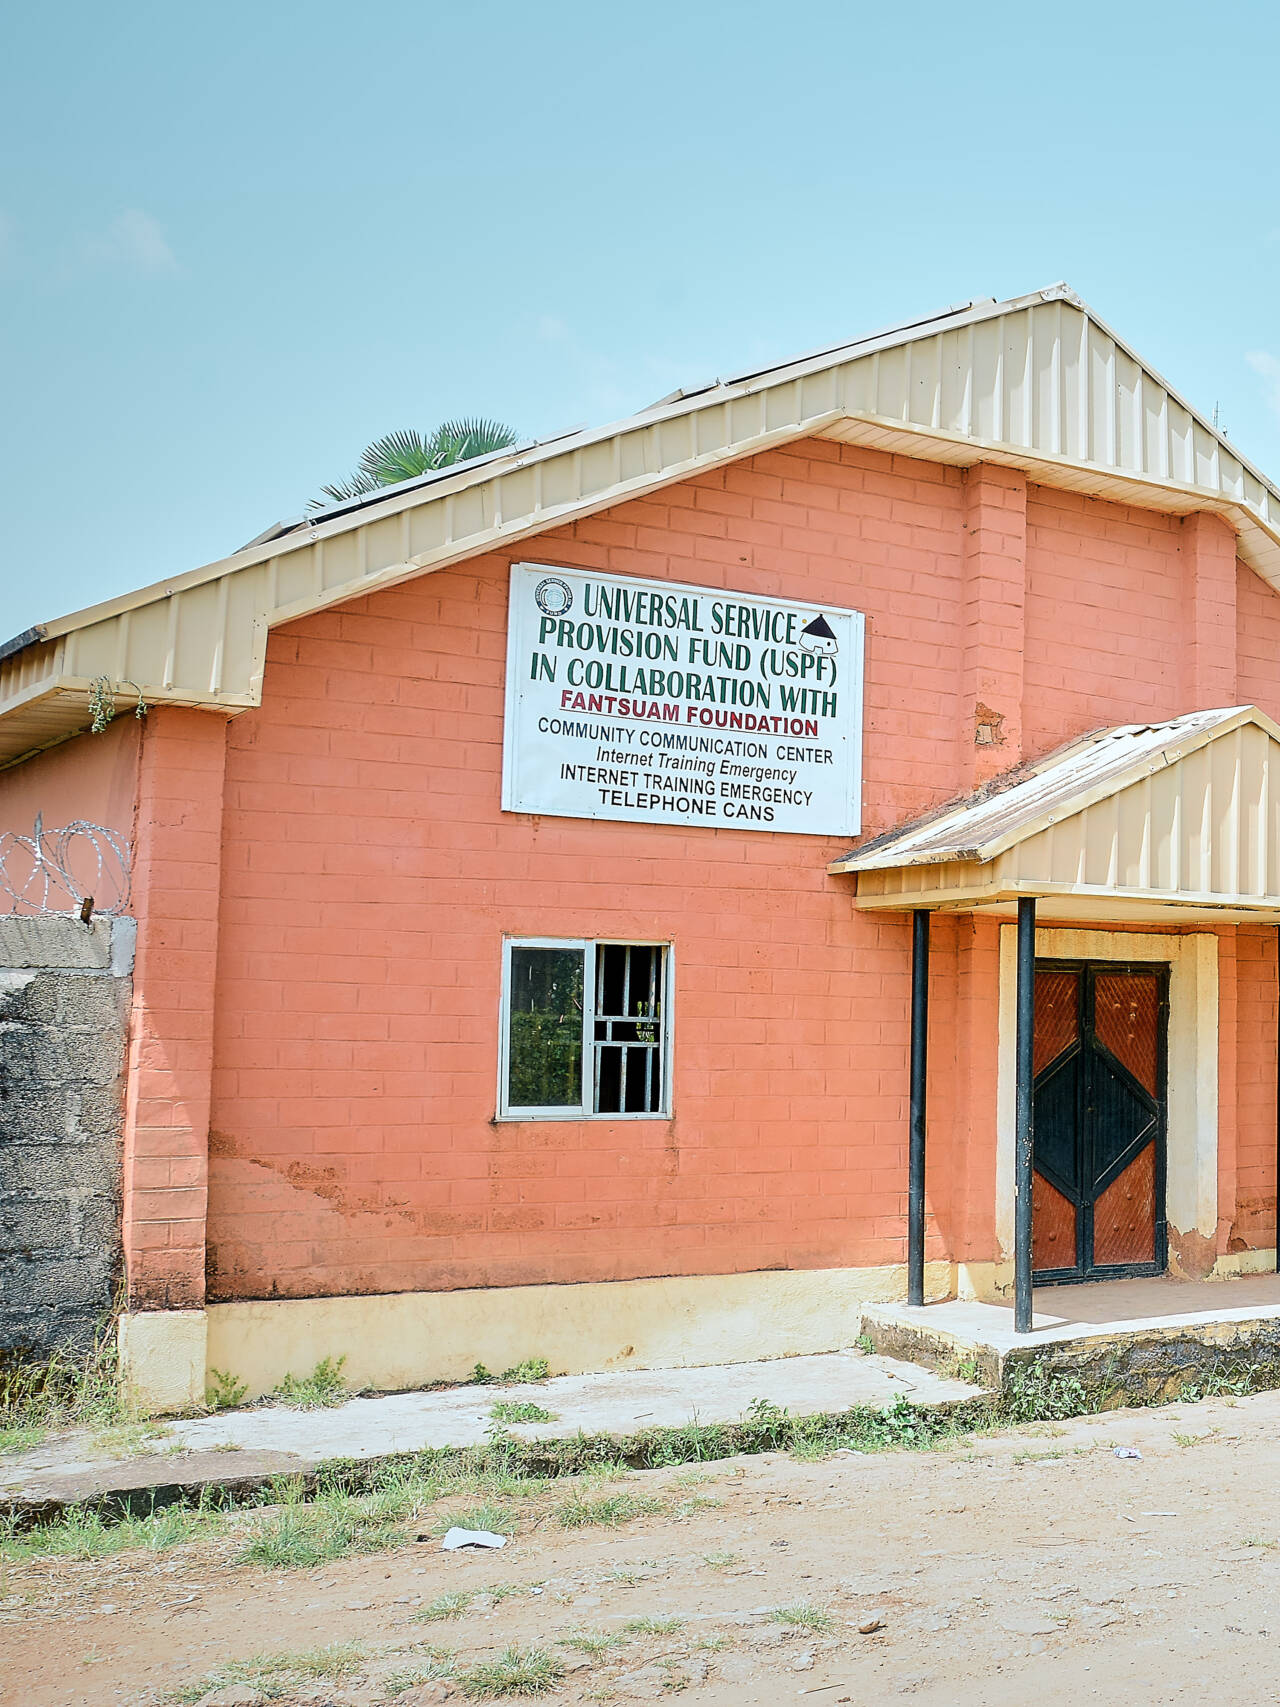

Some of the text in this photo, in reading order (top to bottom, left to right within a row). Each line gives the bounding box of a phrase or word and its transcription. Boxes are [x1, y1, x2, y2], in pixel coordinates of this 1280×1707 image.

[584, 583, 703, 632] UNIVERSAL
[711, 602, 797, 646] SERVICE
[538, 616, 837, 687] PROVISION FUND (USPF)
[530, 652, 837, 718] IN COLLABORATION WITH
[560, 689, 818, 737] FANTSUAM FOUNDATION
[538, 717, 833, 765] COMMUNITY COMMUNICATION CENTER
[560, 763, 813, 807] INTERNET TRAINING EMERGENCY
[596, 746, 797, 785] Internet Training Emergency
[598, 788, 775, 822] TELEPHONE CANS
